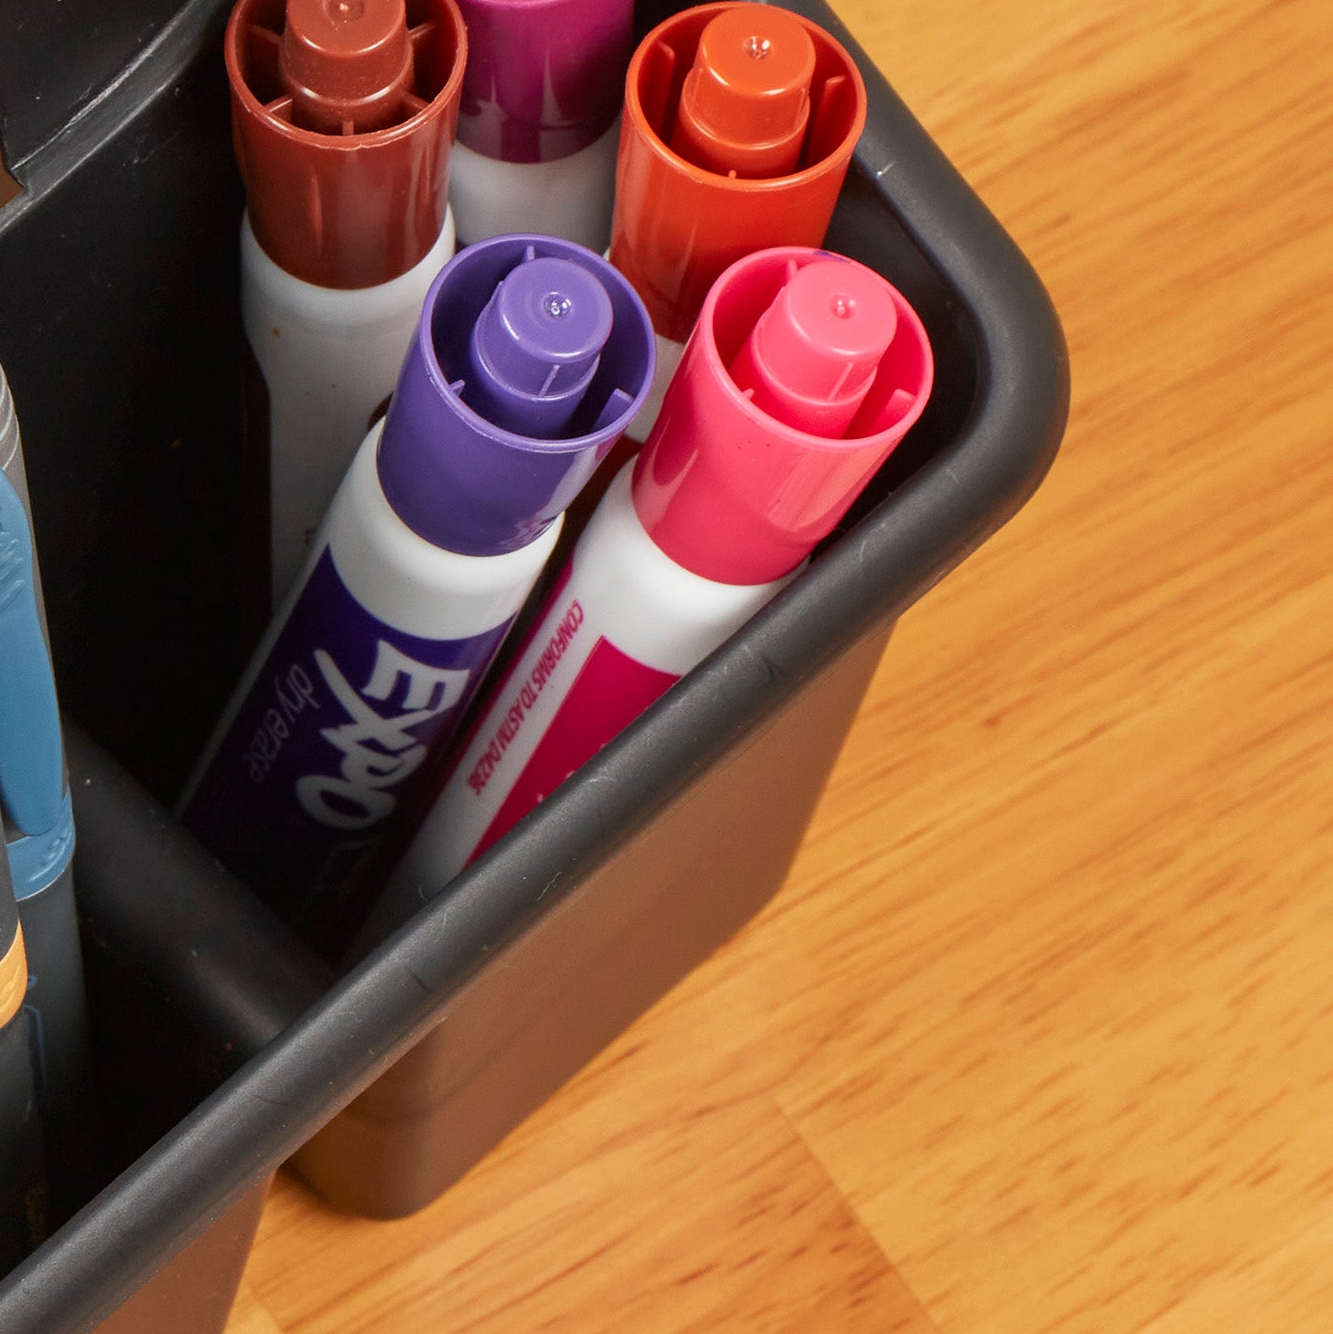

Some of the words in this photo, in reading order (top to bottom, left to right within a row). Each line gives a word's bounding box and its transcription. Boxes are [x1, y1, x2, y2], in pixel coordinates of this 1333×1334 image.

[531, 599, 585, 692] CONFORMS
[274, 664, 322, 724] dry
[494, 699, 525, 752] ASTM
[520, 680, 539, 711] TO
[242, 708, 290, 785] erase
[295, 638, 471, 830] EXPO
